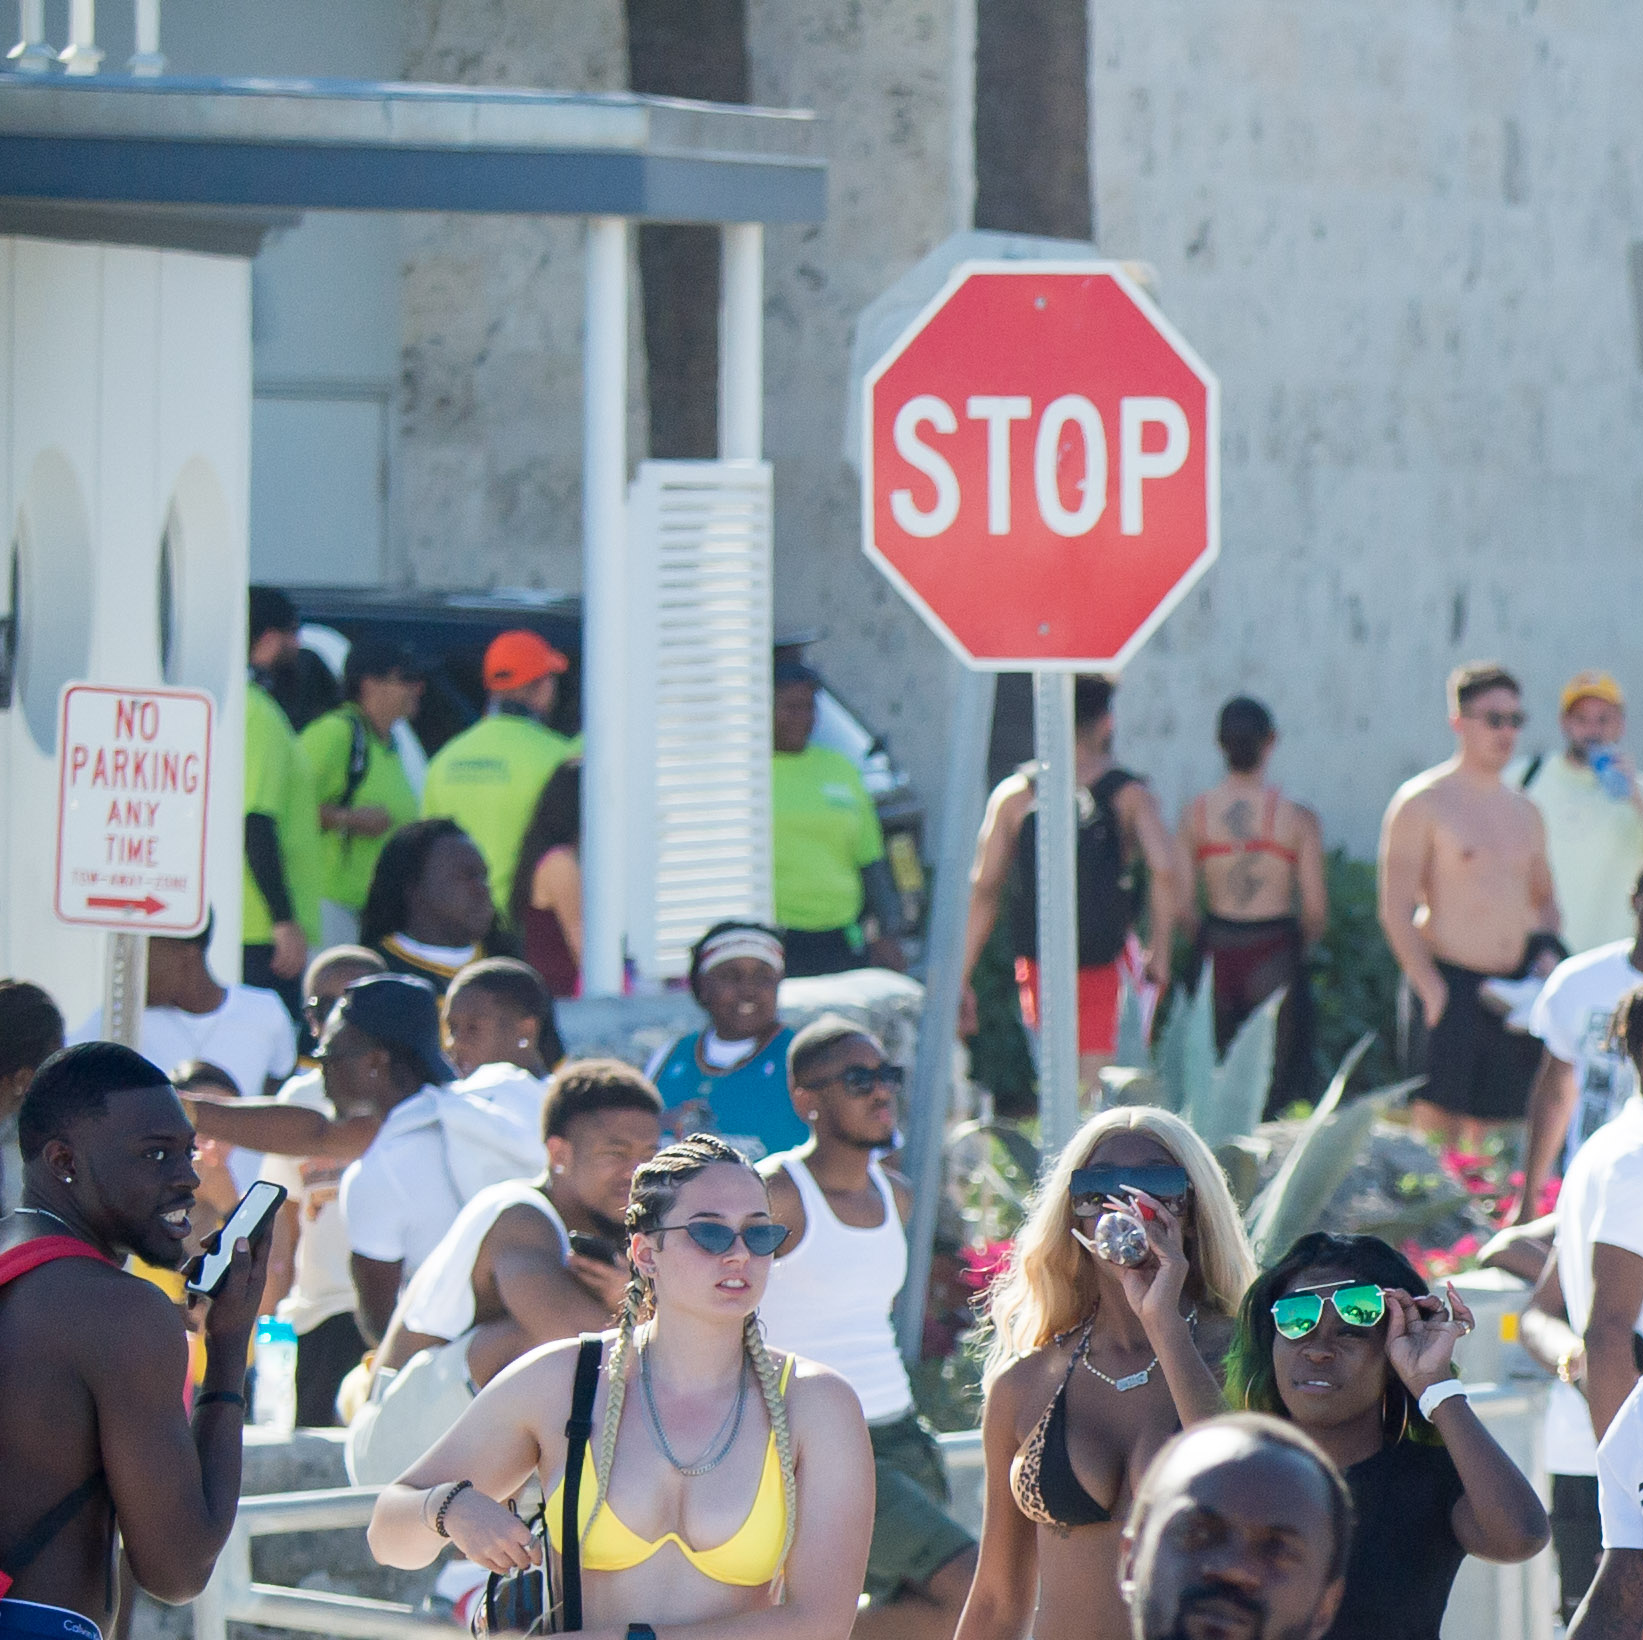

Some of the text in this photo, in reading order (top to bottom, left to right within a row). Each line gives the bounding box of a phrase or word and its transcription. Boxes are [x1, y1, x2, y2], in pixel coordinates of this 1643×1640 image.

[889, 394, 1191, 538] STOP
[115, 699, 160, 742] NO
[71, 745, 199, 794] PARKING
[105, 799, 160, 828] ANY
[105, 835, 159, 868] TIME
